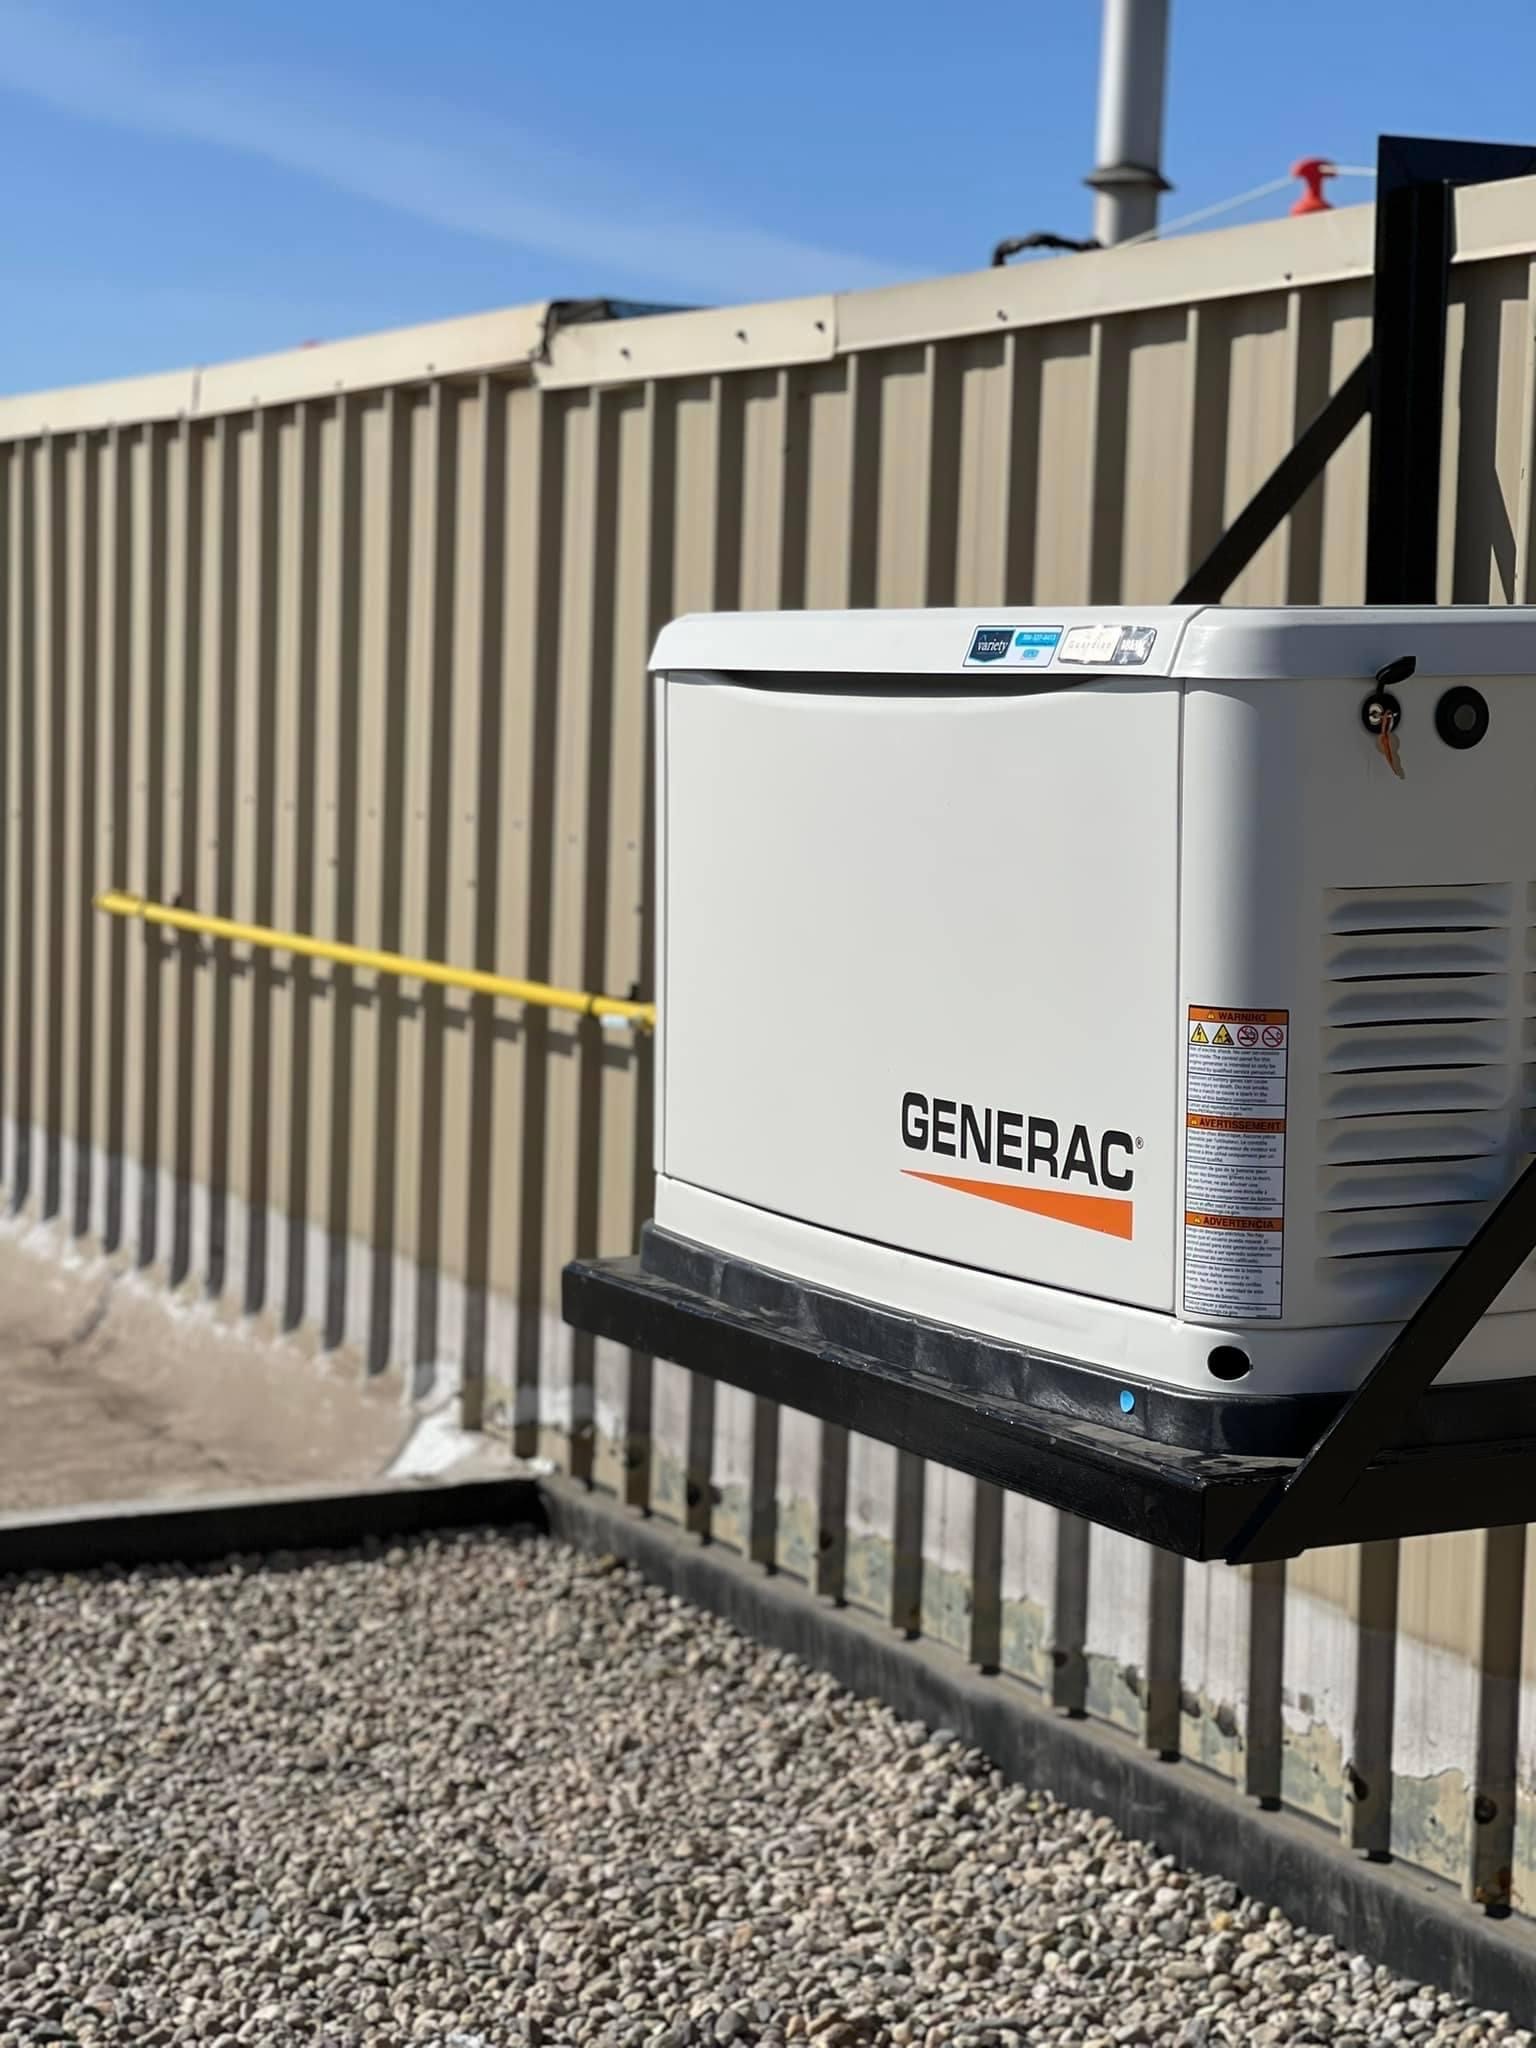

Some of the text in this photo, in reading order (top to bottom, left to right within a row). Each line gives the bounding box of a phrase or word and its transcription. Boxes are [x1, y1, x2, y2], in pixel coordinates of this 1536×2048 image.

[978, 639, 1008, 655] variety
[1218, 1012, 1266, 1022] WARNING
[1199, 1118, 1281, 1130] AVERTISSEMENT
[902, 1091, 1134, 1192] GENERAC
[1202, 1217, 1274, 1229] ADVERTENCIA
